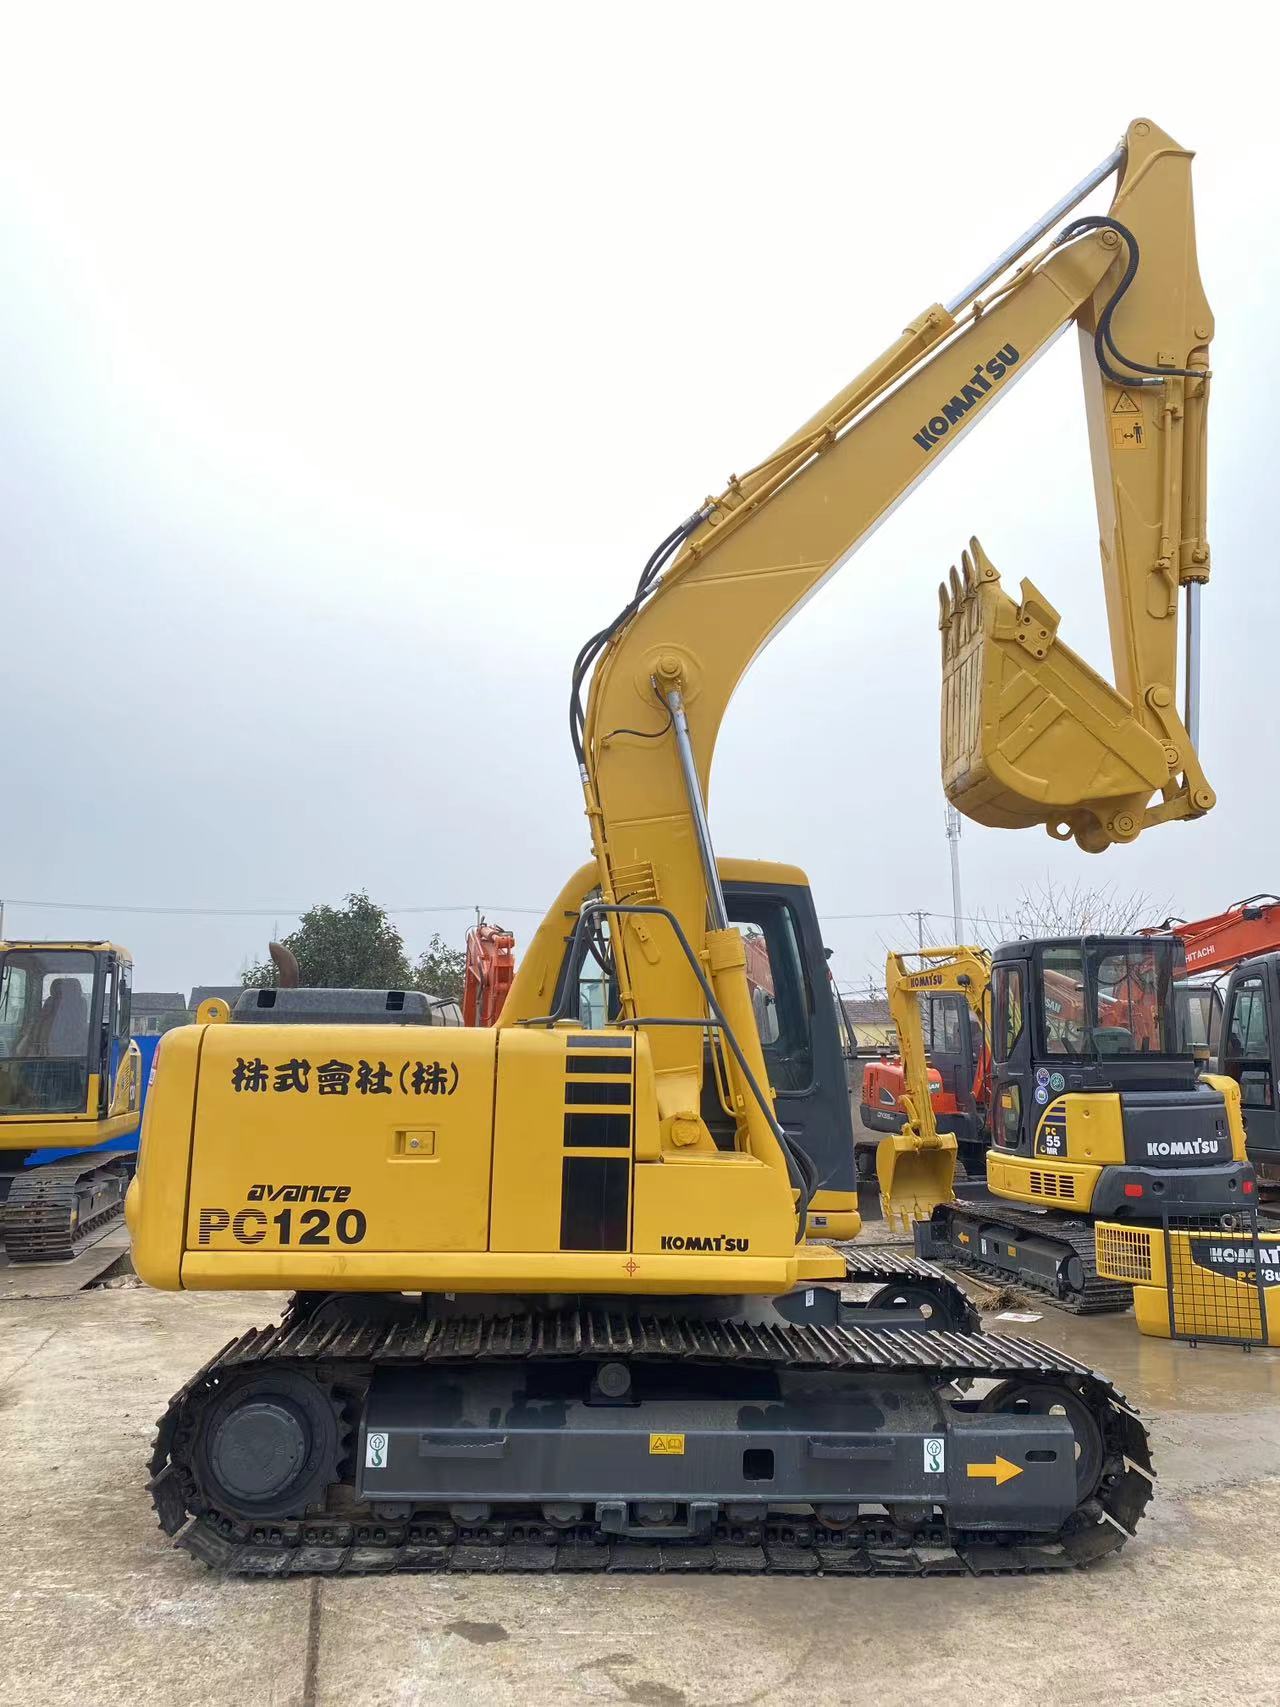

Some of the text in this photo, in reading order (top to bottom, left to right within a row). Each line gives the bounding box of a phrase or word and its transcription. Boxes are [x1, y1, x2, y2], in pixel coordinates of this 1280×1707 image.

[912, 343, 1020, 452] KOMATSU
[1185, 944, 1216, 963] HITACHI
[910, 973, 943, 988] KOMATSU
[1046, 1135, 1061, 1148] 55
[1147, 1137, 1219, 1156] KOMATSU
[1046, 1147, 1058, 1156] MR
[247, 1184, 352, 1203] avance
[198, 1208, 367, 1245] PC120
[661, 1234, 749, 1252] KOMATSU
